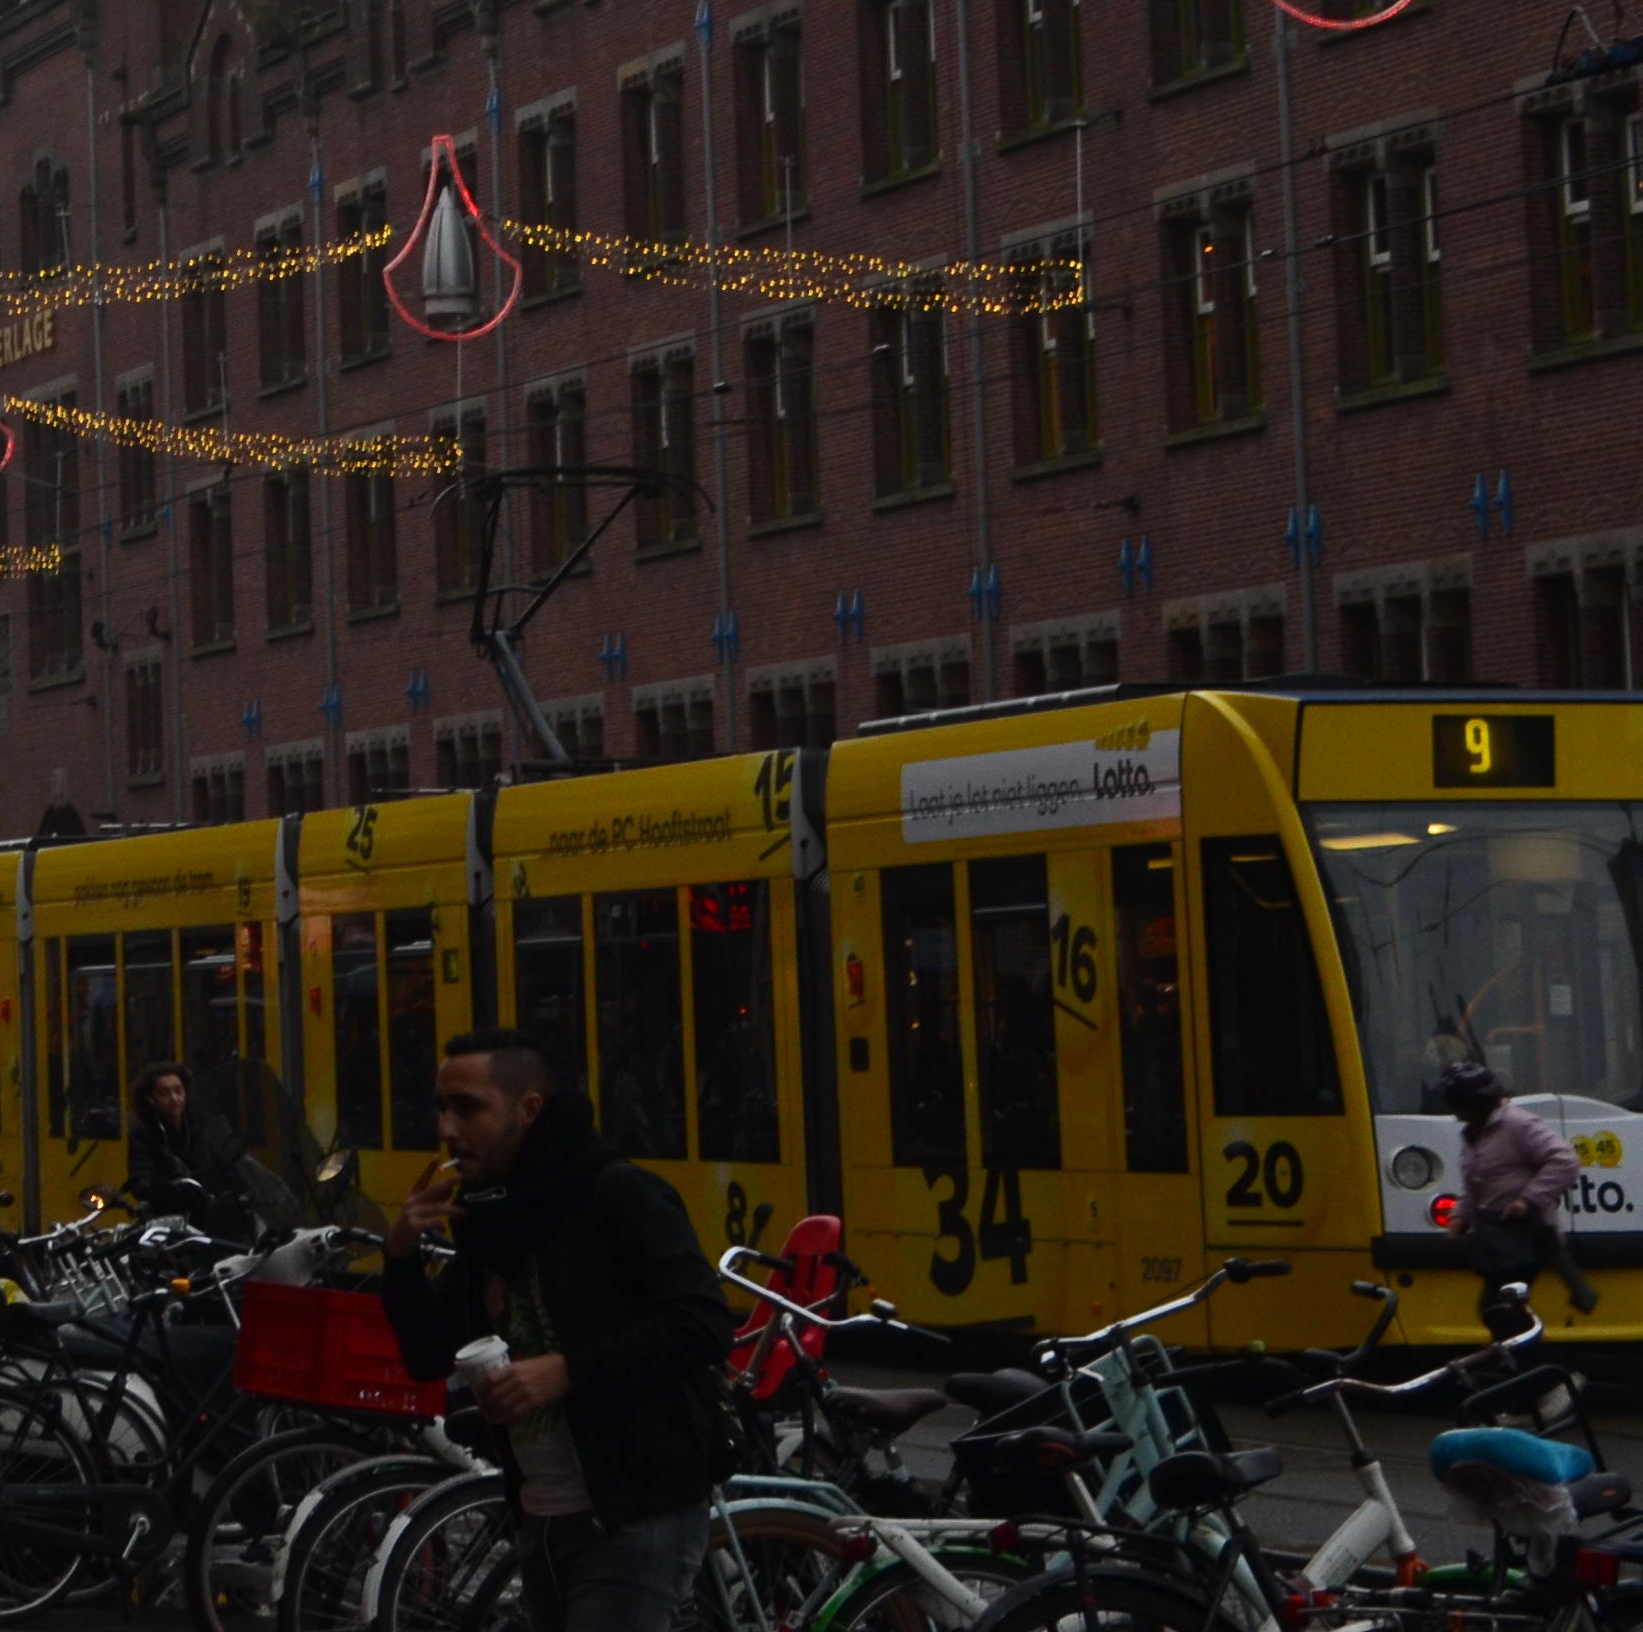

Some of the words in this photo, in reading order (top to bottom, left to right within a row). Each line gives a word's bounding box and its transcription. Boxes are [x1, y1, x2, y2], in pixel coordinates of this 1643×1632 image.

[1464, 717, 1491, 774] 9
[346, 804, 378, 861] 25
[1052, 913, 1097, 1004] 16
[1223, 1140, 1303, 1208] 20
[922, 1167, 1032, 1295] 34
